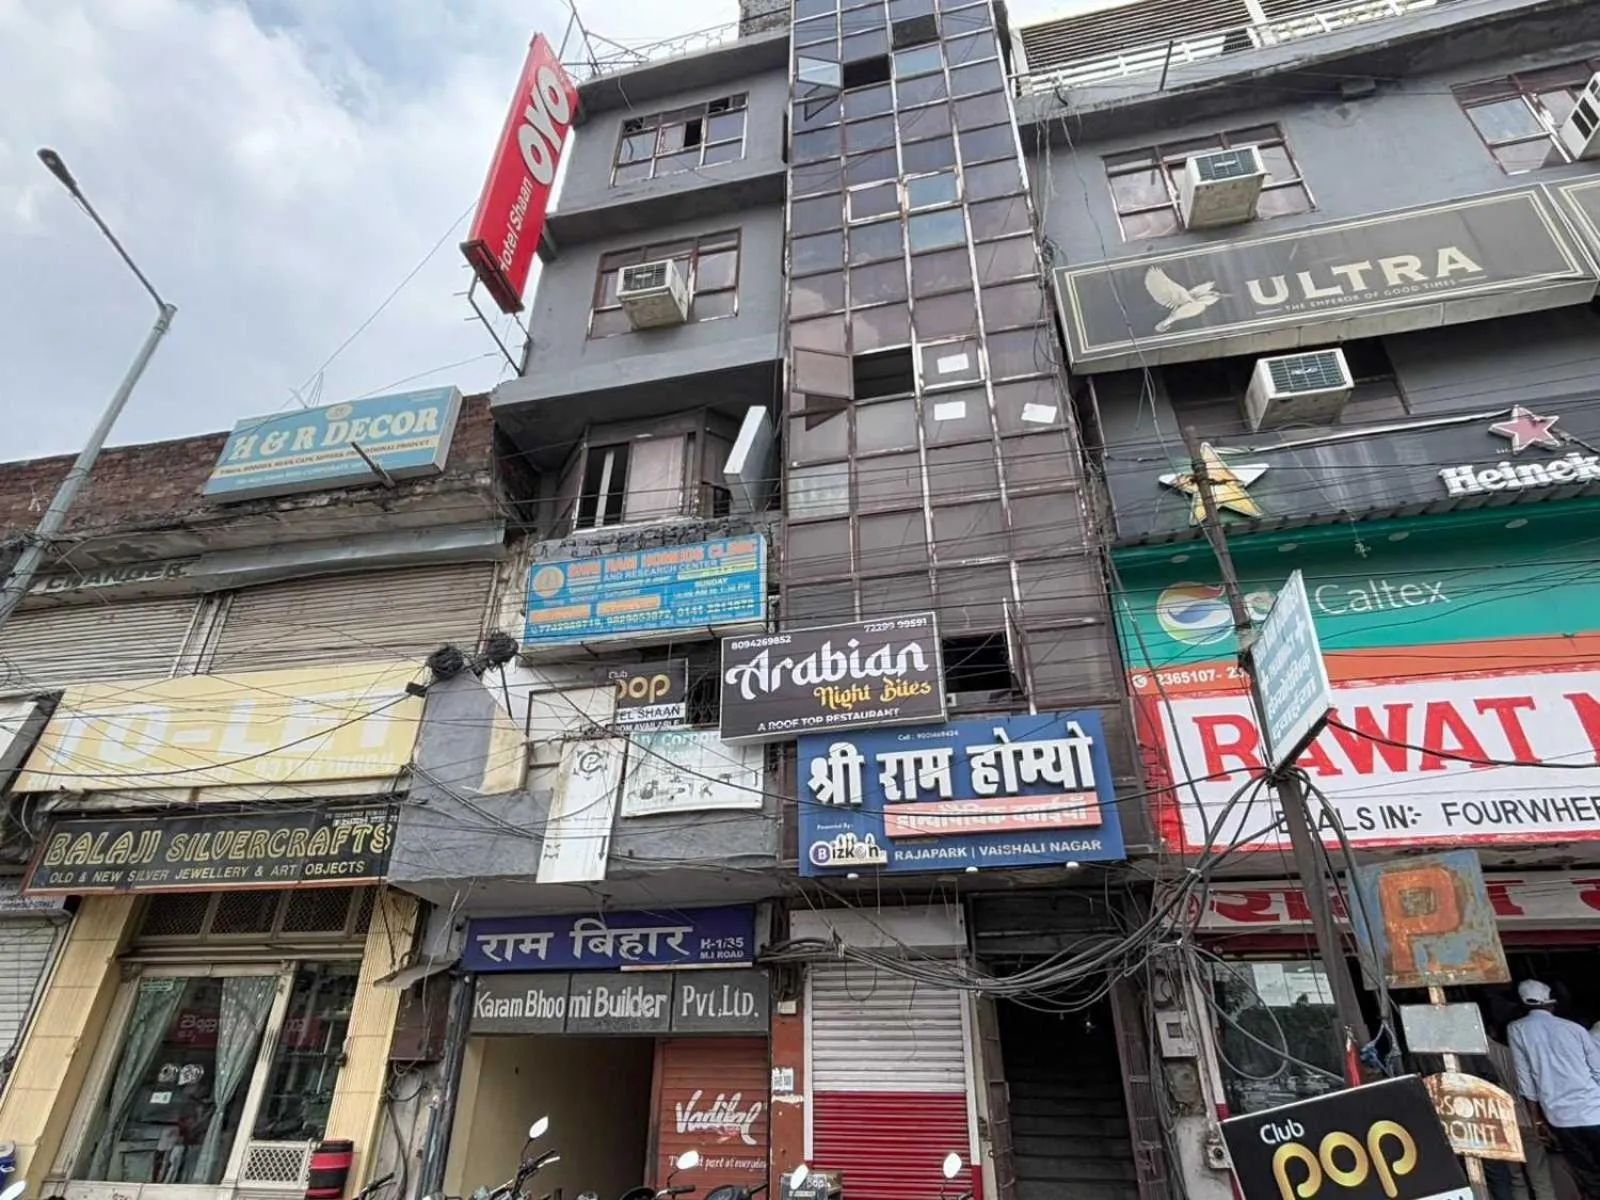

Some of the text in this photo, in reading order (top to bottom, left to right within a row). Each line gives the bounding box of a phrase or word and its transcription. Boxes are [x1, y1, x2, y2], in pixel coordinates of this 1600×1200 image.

[518, 65, 570, 186] OYO
[510, 176, 534, 231] Shaan
[1246, 246, 1483, 305] ULTRA
[1285, 303, 1305, 312] THE
[1364, 290, 1379, 301] OF
[1384, 285, 1419, 296] GOOD
[1423, 279, 1456, 290] TIMES
[259, 430, 291, 455] &
[293, 425, 318, 450] R
[320, 406, 439, 446] DECOR
[1315, 579, 1451, 616] Caltex
[731, 635, 791, 650] 8094269852
[725, 638, 929, 700] Arabian
[637, 705, 681, 720] SHAAN
[813, 676, 933, 710] Night Bites
[45, 689, 408, 767] TO-LET
[757, 706, 901, 732] A ROOF TOP RESTAURANT
[807, 721, 1096, 804] श्री राम होम्यो
[44, 823, 393, 866] BALAJI SILVERCRAFTS
[895, 847, 967, 862] RAJAPARK
[979, 843, 1046, 857] VAISHALI
[1050, 839, 1102, 854] NAGAR
[50, 872, 74, 884] OLD
[92, 871, 124, 882] NEW
[128, 869, 169, 882] SILVER
[175, 866, 249, 880] JEWELLERY
[255, 865, 264, 877] &
[271, 864, 298, 876] ART
[305, 860, 366, 876] OBJECTS
[477, 917, 694, 962] राम बिहार
[1378, 865, 1465, 979] P
[717, 950, 745, 959] ROAD
[473, 991, 524, 1018] Karam
[594, 986, 667, 1018] Builder
[675, 1089, 763, 1145] Vadilal
[1260, 1120, 1305, 1145] Club
[1272, 1120, 1417, 1200] pop
